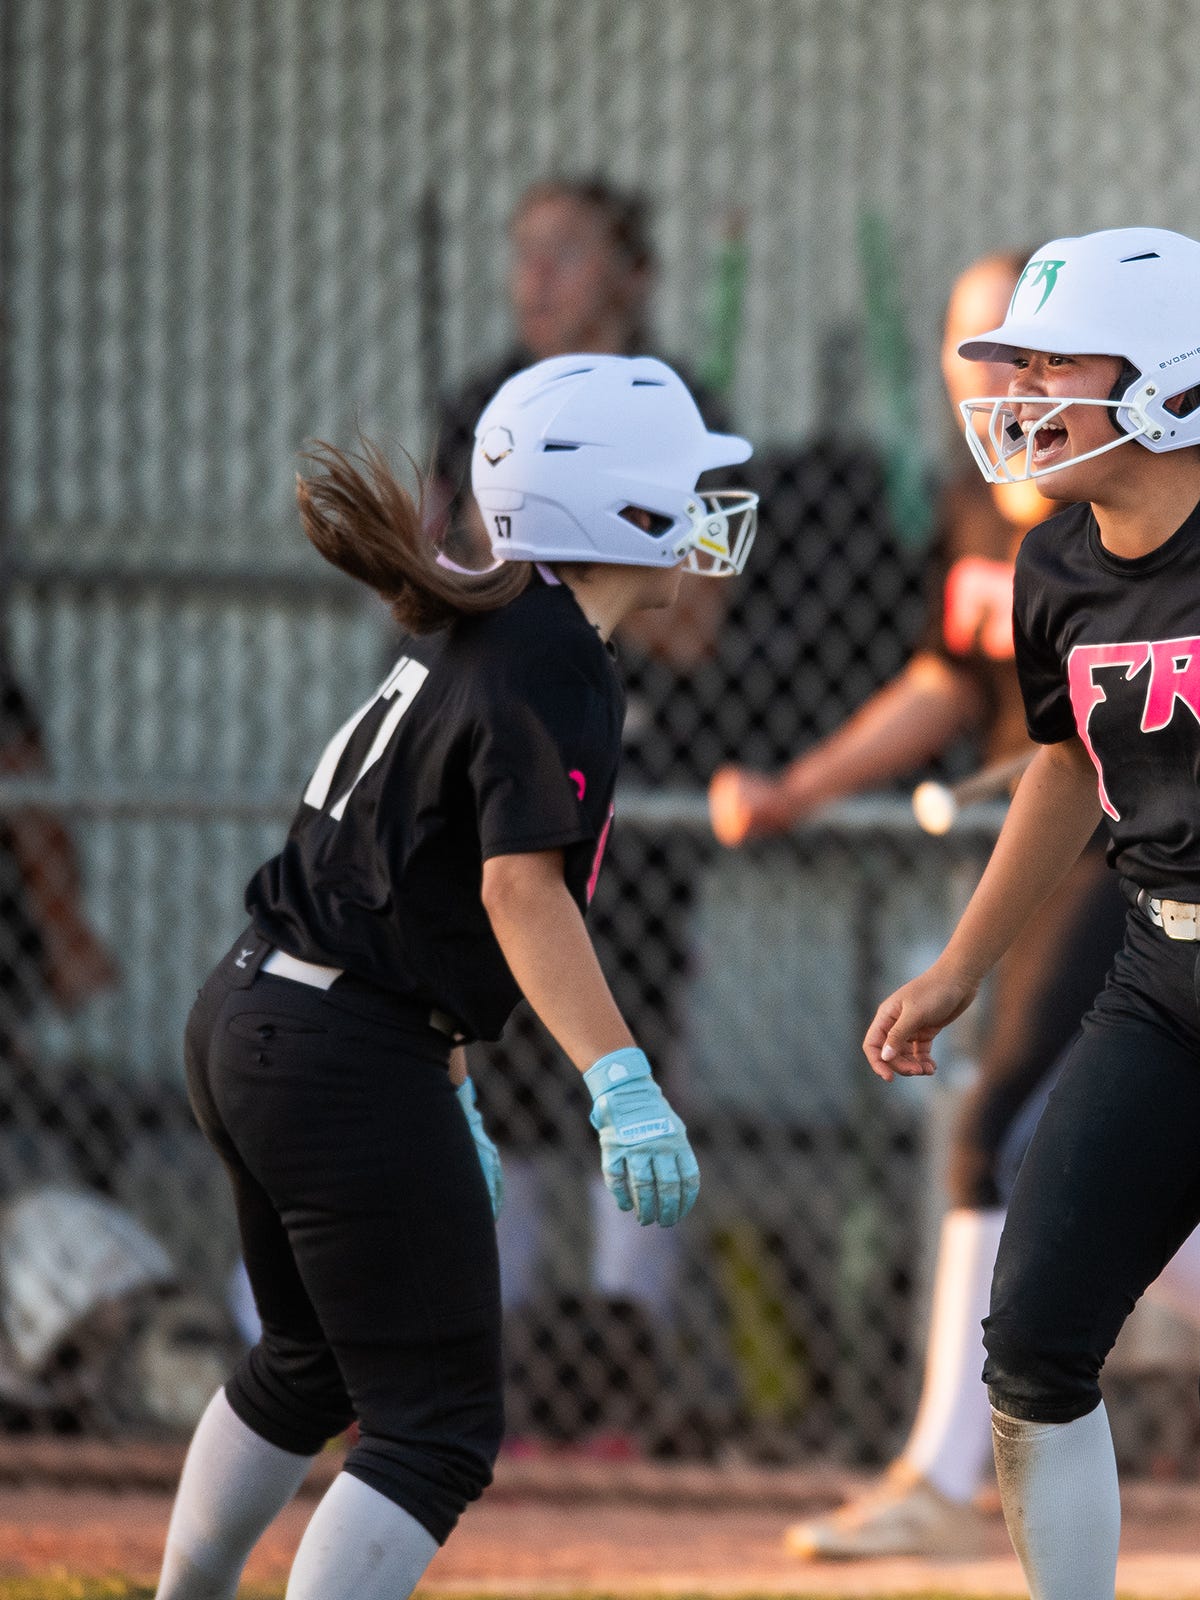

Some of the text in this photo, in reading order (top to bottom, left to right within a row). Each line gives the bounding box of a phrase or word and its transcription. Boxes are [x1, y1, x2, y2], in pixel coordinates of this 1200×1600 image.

[1011, 260, 1066, 315] FR
[494, 515, 511, 538] 17
[304, 655, 430, 822] 17
